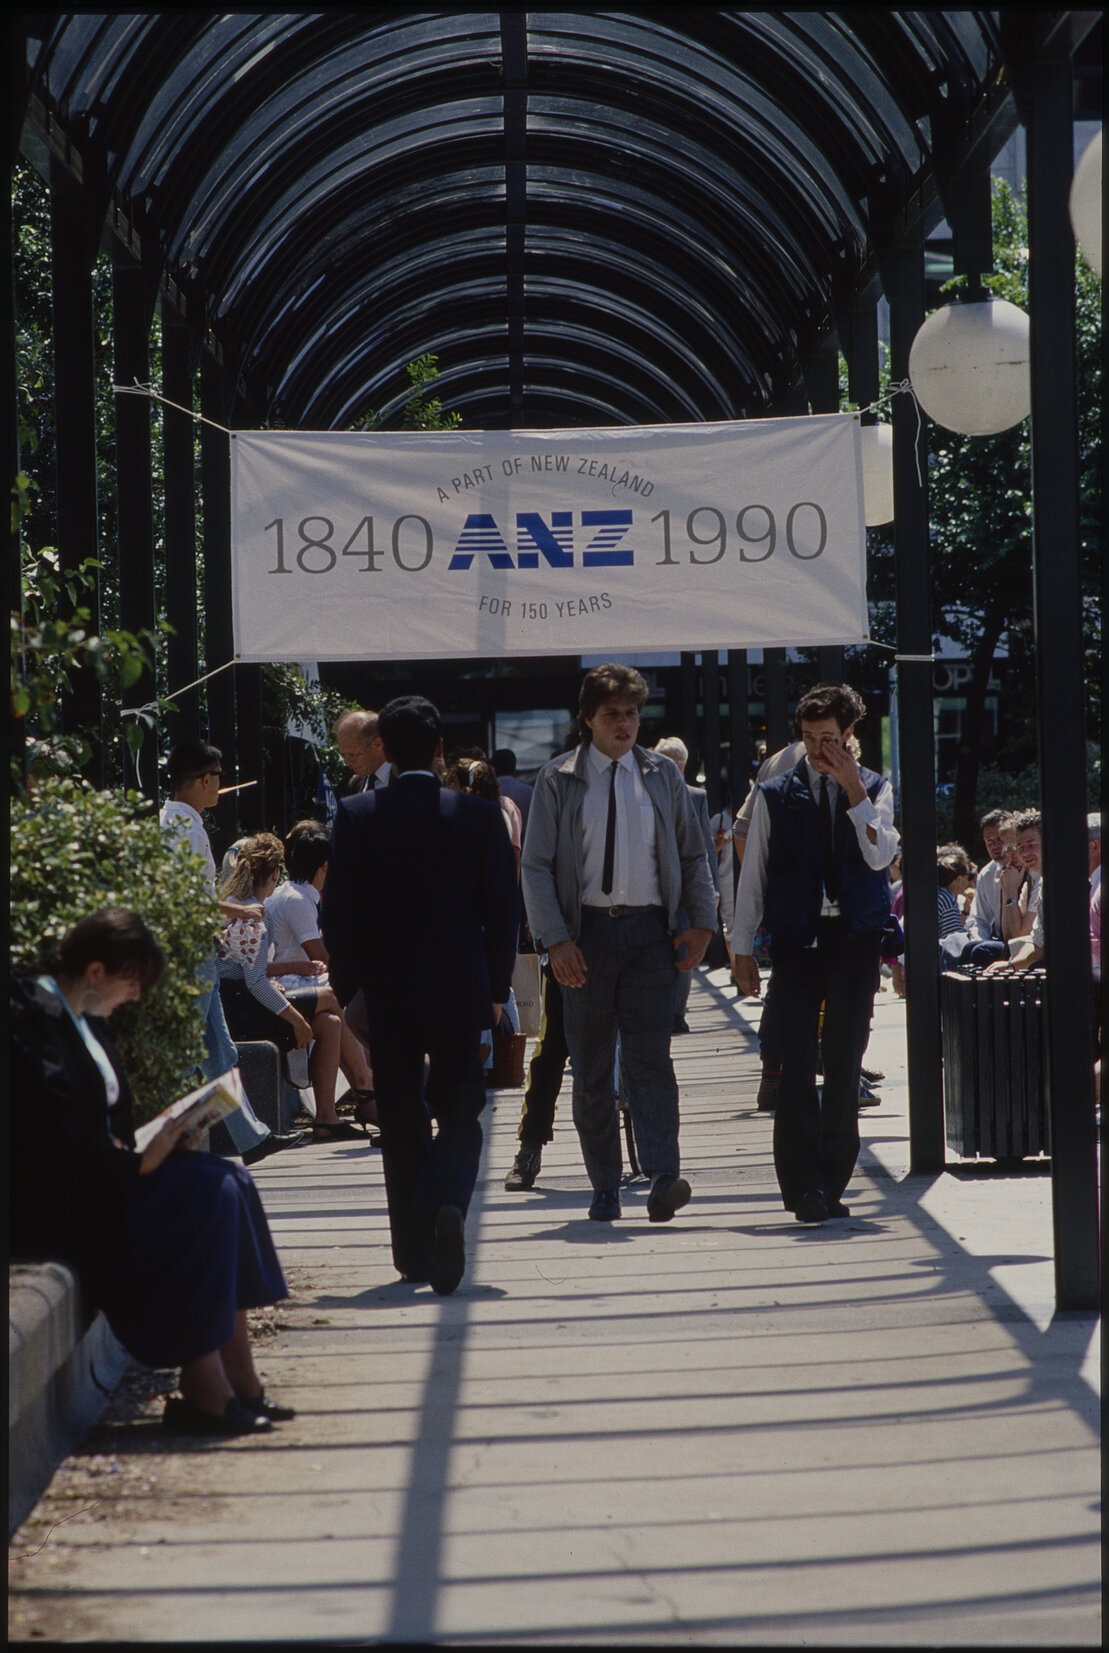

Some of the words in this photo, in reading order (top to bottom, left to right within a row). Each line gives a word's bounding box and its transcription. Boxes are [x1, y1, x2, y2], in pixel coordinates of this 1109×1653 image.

[437, 486, 450, 504] A
[451, 464, 493, 494] PART
[501, 458, 522, 477] OF
[531, 454, 568, 472] NEW
[577, 459, 656, 499] ZEALAND
[264, 514, 434, 575] 1840
[447, 510, 635, 571] ANZ
[650, 501, 828, 566] 1990
[479, 595, 512, 617] FOR
[521, 602, 548, 620] 150
[556, 592, 612, 618] YEARS
